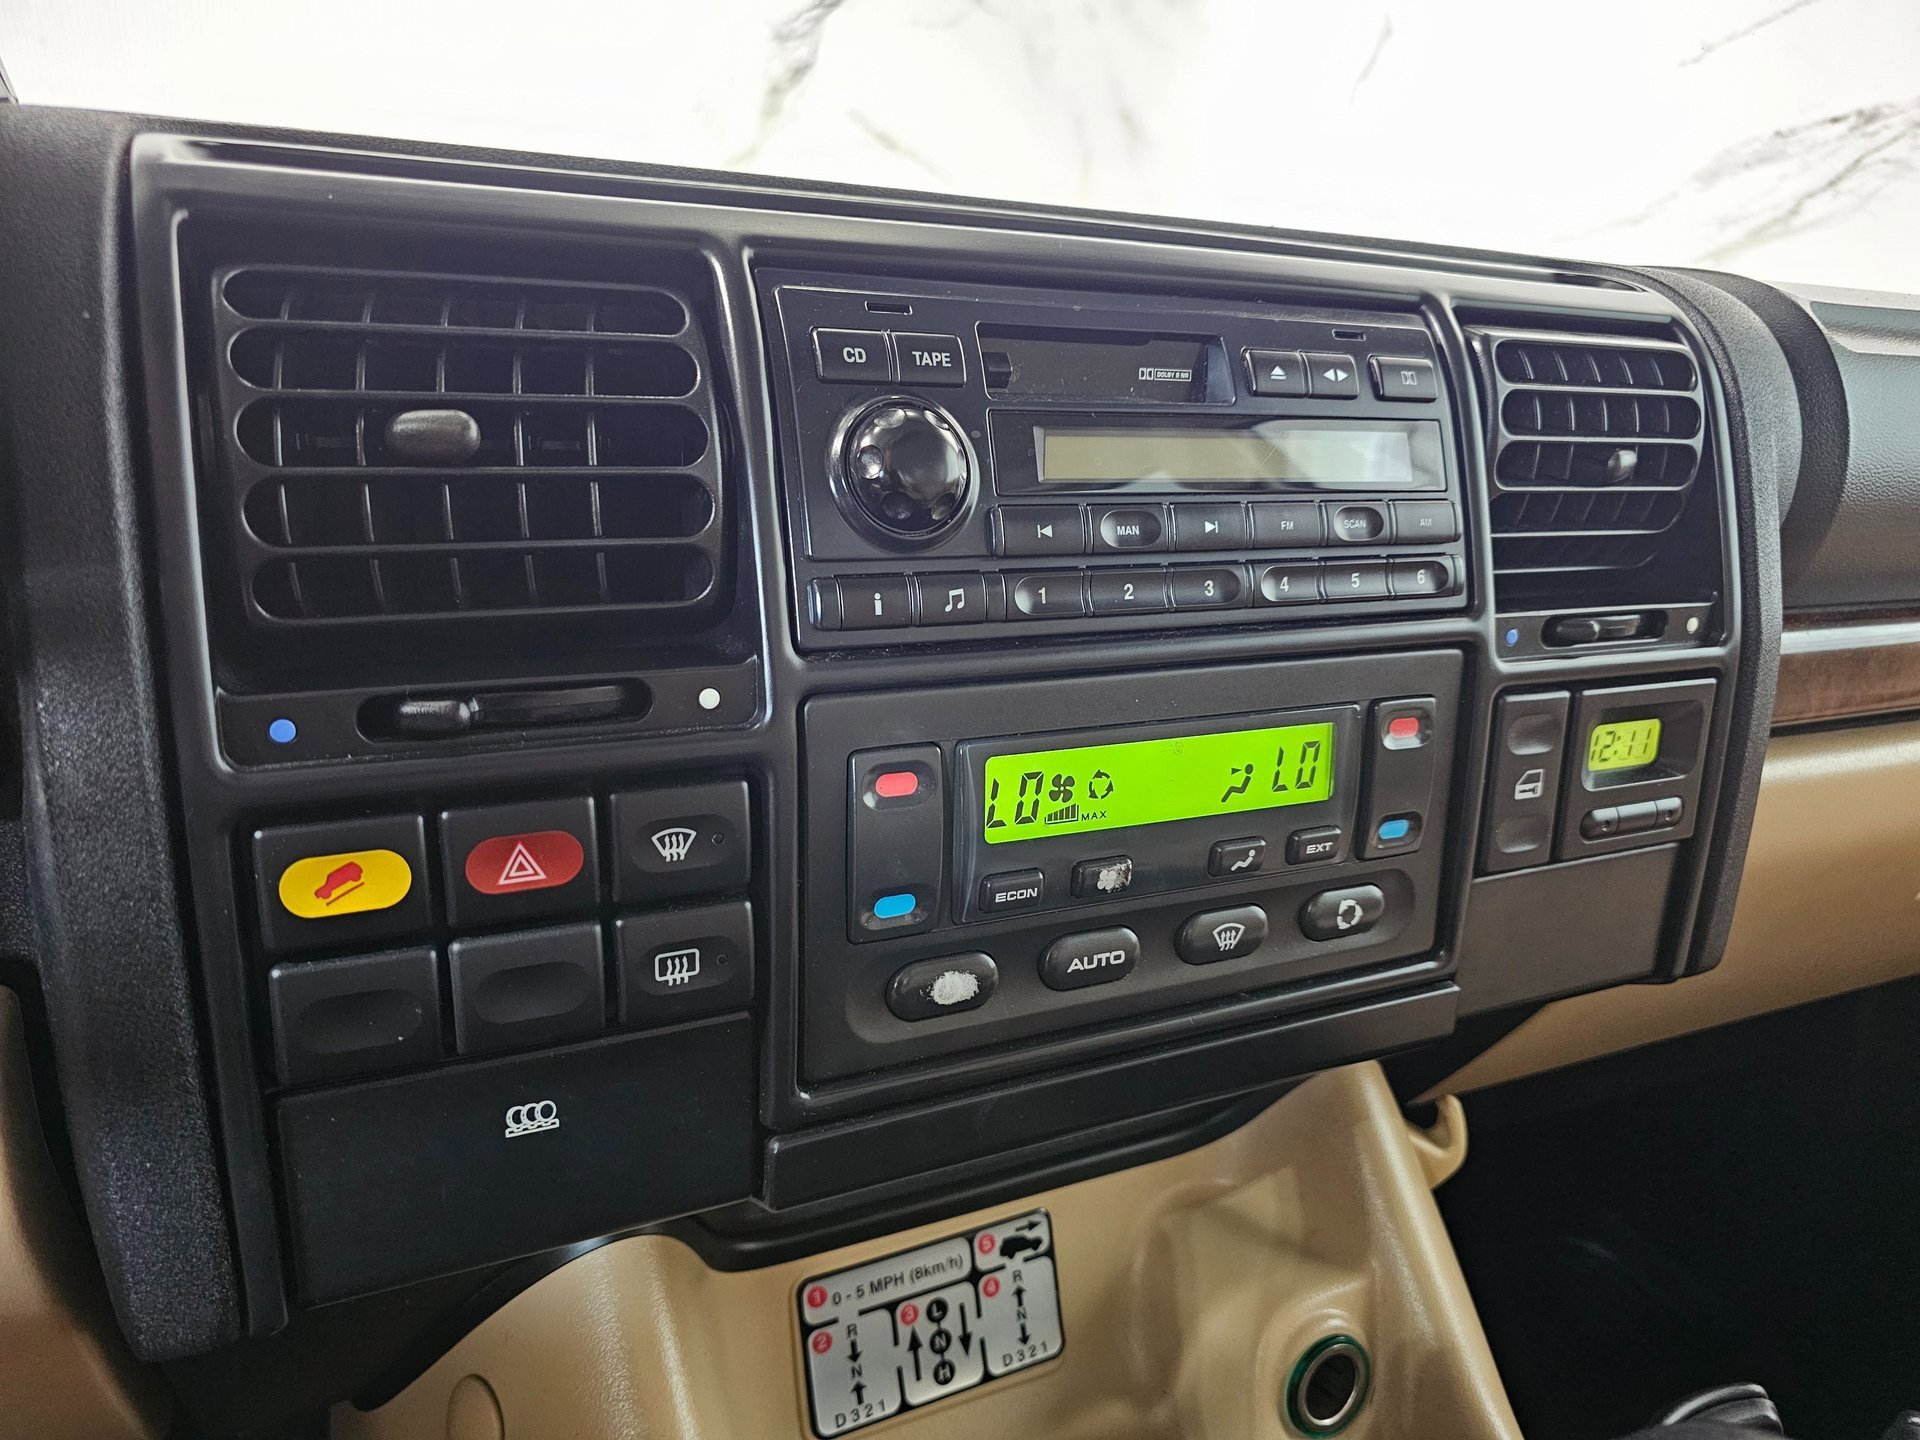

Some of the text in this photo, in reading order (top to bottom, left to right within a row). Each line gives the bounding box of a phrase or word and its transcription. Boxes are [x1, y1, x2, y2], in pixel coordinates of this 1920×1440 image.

[842, 346, 867, 364] CD
[911, 350, 953, 368] TAPE
[1156, 370, 1175, 378] DOLBY
[1280, 520, 1295, 531] FM
[1343, 519, 1368, 529] SCAN
[1419, 517, 1433, 527] AM
[1116, 525, 1141, 536] MAN
[1279, 576, 1290, 592] 4
[1351, 573, 1360, 588] 5
[1416, 569, 1426, 584] 6
[1038, 587, 1047, 604] 1
[1123, 583, 1135, 600] 2
[1204, 580, 1215, 597] 3
[1590, 728, 1652, 763] 12:11
[1081, 810, 1107, 822] MAX
[1305, 841, 1334, 855] EXT
[995, 887, 1038, 903] ECON
[1067, 950, 1126, 973] AUTO
[856, 1286, 866, 1298] 5
[869, 1271, 904, 1294] MPH
[909, 1253, 963, 1285] (8km/h)
[1013, 1270, 1023, 1283] R
[931, 1303, 943, 1318] L
[1016, 1306, 1027, 1321] N
[847, 1323, 858, 1338] R
[934, 1333, 946, 1349] N
[851, 1363, 862, 1378] N
